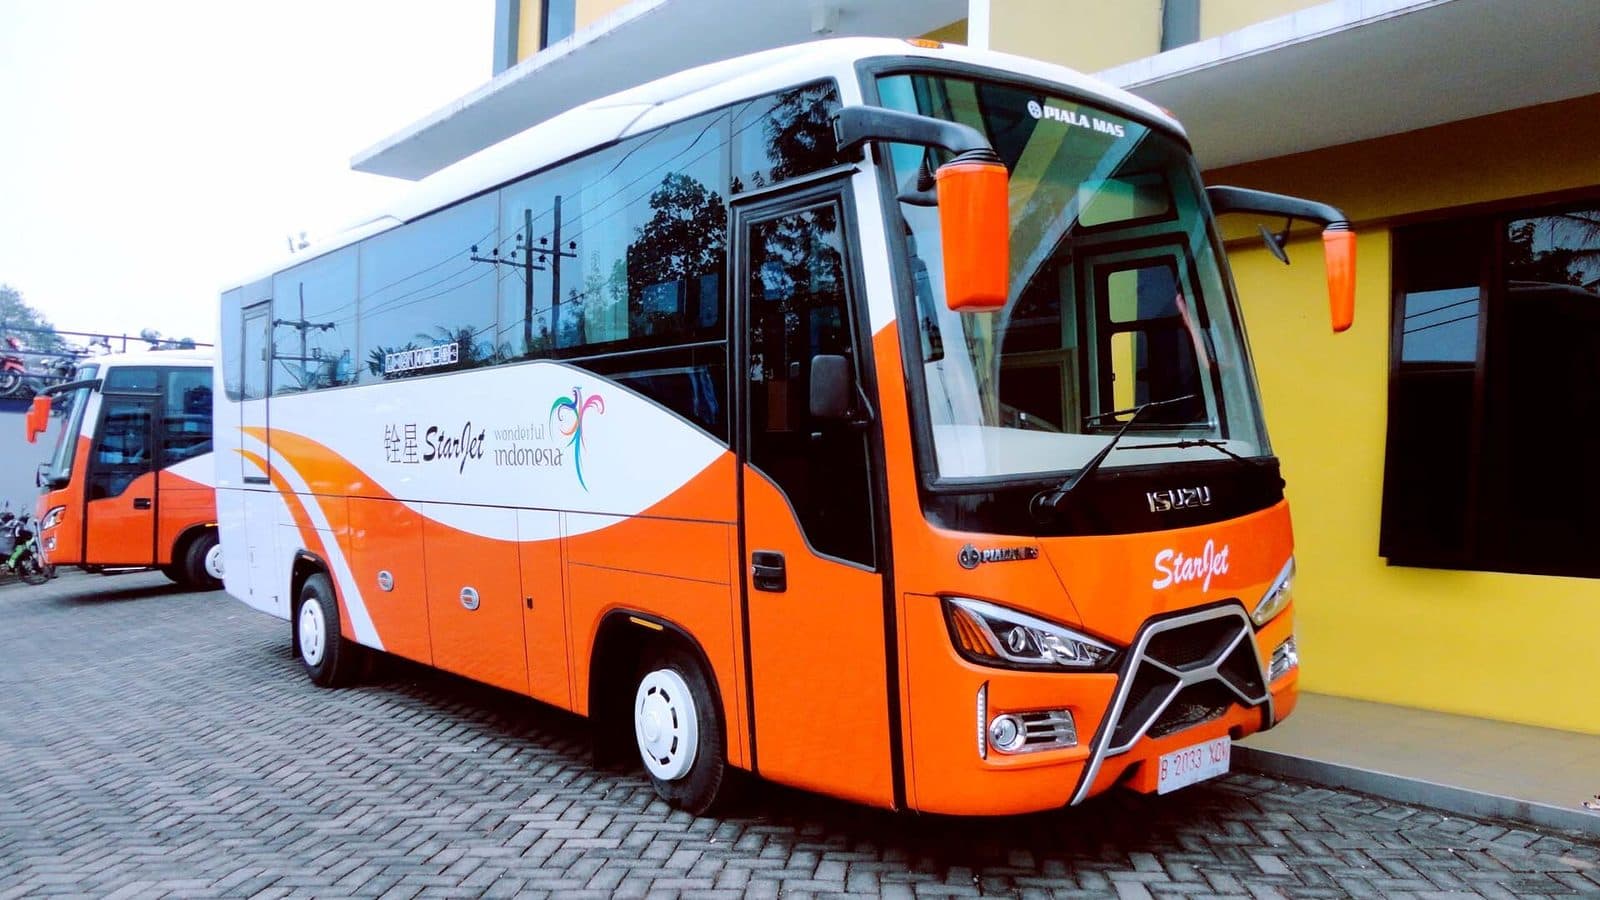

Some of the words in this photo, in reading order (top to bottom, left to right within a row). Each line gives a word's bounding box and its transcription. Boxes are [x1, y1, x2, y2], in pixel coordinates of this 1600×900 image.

[1043, 105, 1090, 128] PIALA
[1092, 118, 1124, 137] MAS
[494, 423, 545, 441] wonderful
[423, 421, 485, 474] StarJet
[494, 443, 563, 466] indonesia
[1146, 486, 1211, 512] ISUZU
[1152, 538, 1229, 592] StarJet
[1161, 759, 1168, 780] B
